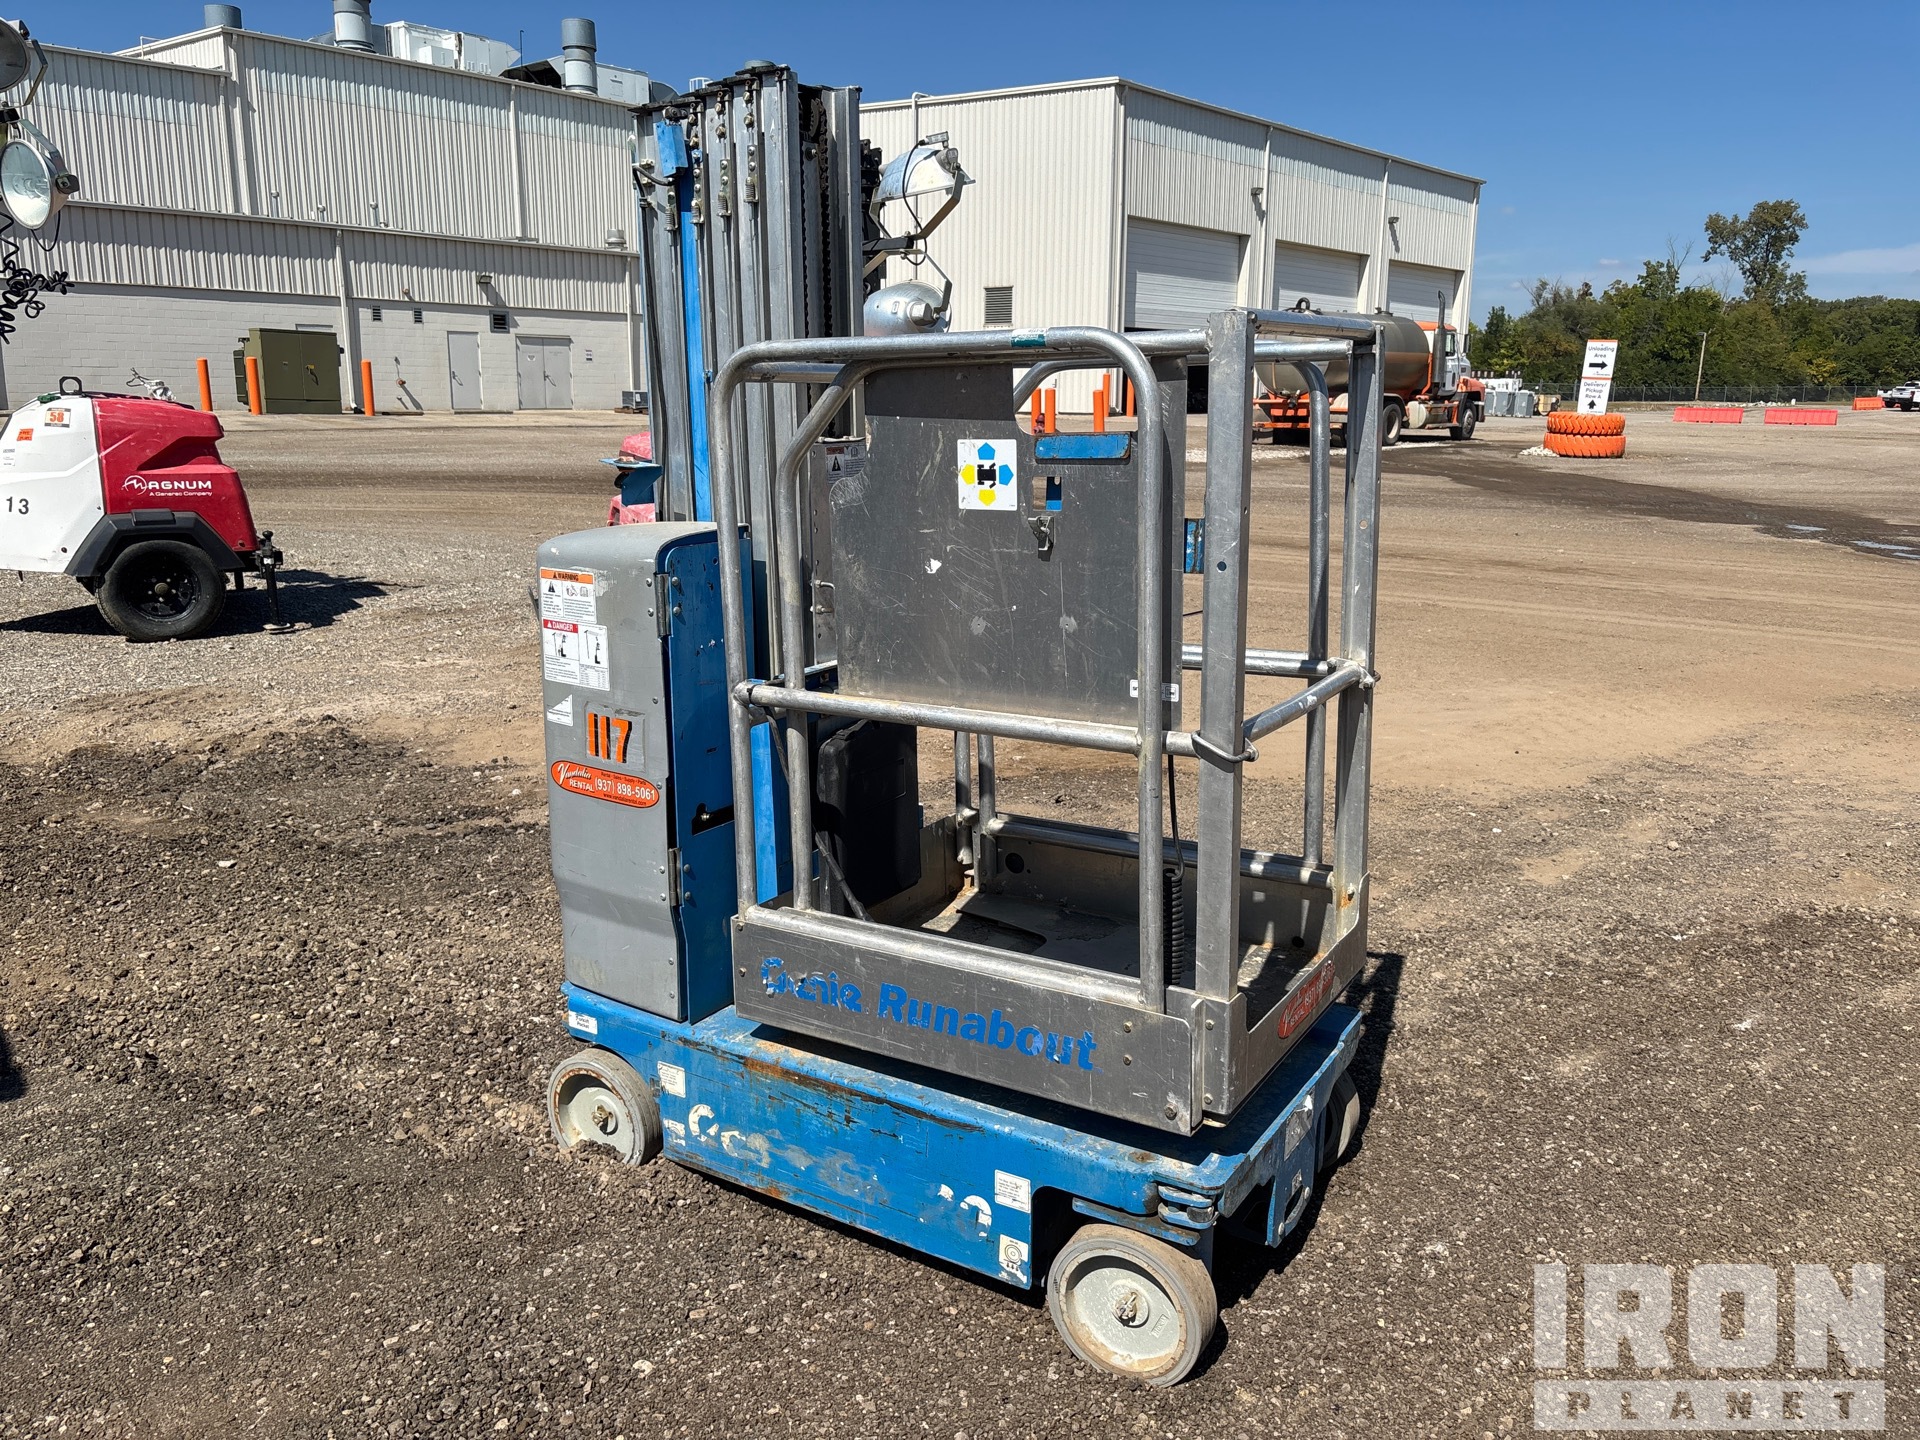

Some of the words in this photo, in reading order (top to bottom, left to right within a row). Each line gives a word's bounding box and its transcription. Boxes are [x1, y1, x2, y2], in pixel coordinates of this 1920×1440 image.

[1583, 381, 1607, 389] Delivery/
[49, 412, 65, 423] 58
[121, 475, 212, 495] MAGNUM
[6, 496, 30, 515] 13
[557, 573, 579, 582] WARNING
[552, 621, 574, 632] DANGER
[588, 712, 633, 764] 117
[569, 779, 595, 792] RENTAL
[594, 777, 615, 794] (937)
[617, 782, 655, 801] 898-5061
[877, 982, 1097, 1071] Runabout
